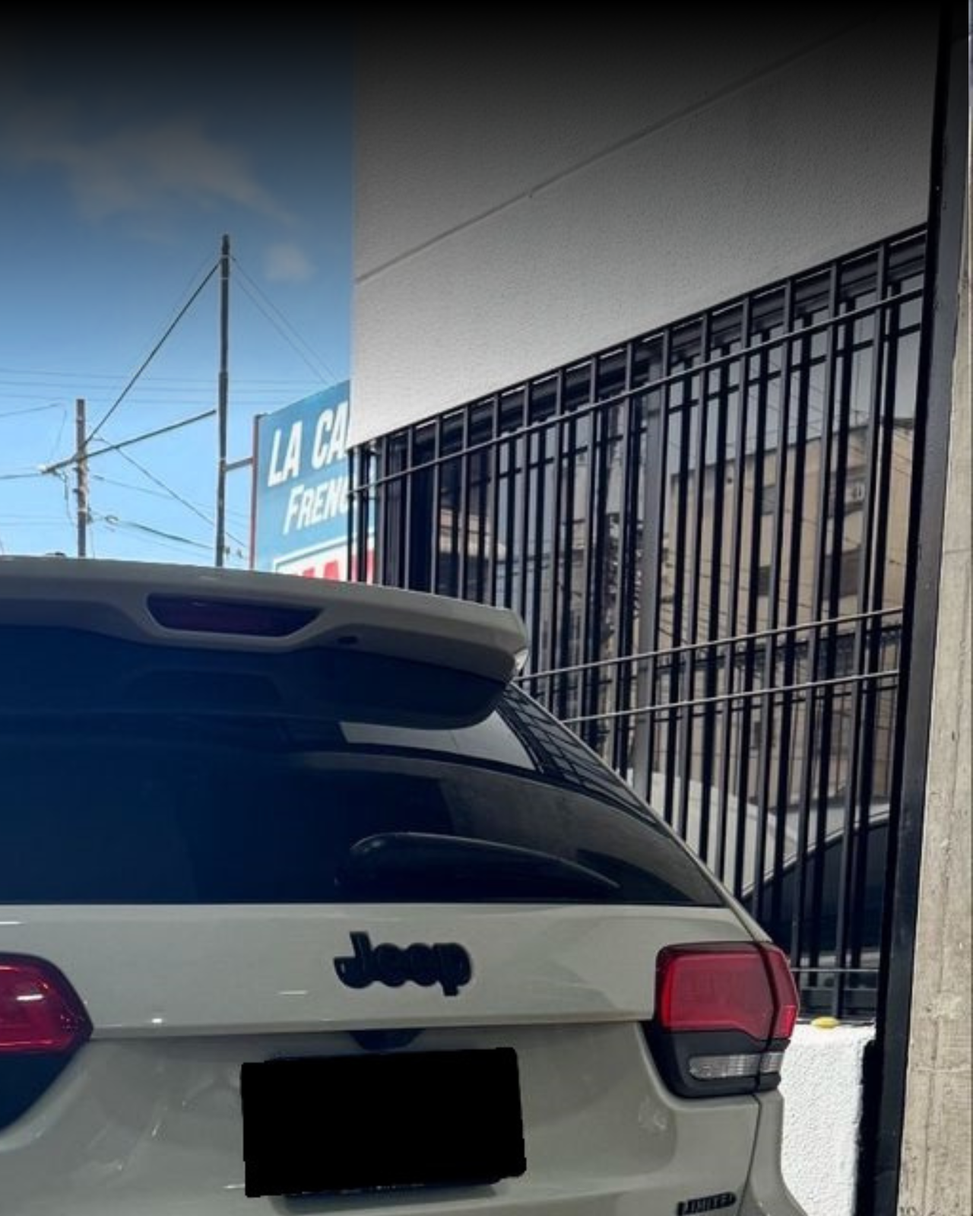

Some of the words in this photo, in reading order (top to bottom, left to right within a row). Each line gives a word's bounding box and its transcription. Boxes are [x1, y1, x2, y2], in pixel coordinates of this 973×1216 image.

[267, 419, 303, 487] LA
[311, 400, 351, 470] CA
[333, 931, 472, 997] Jeep
